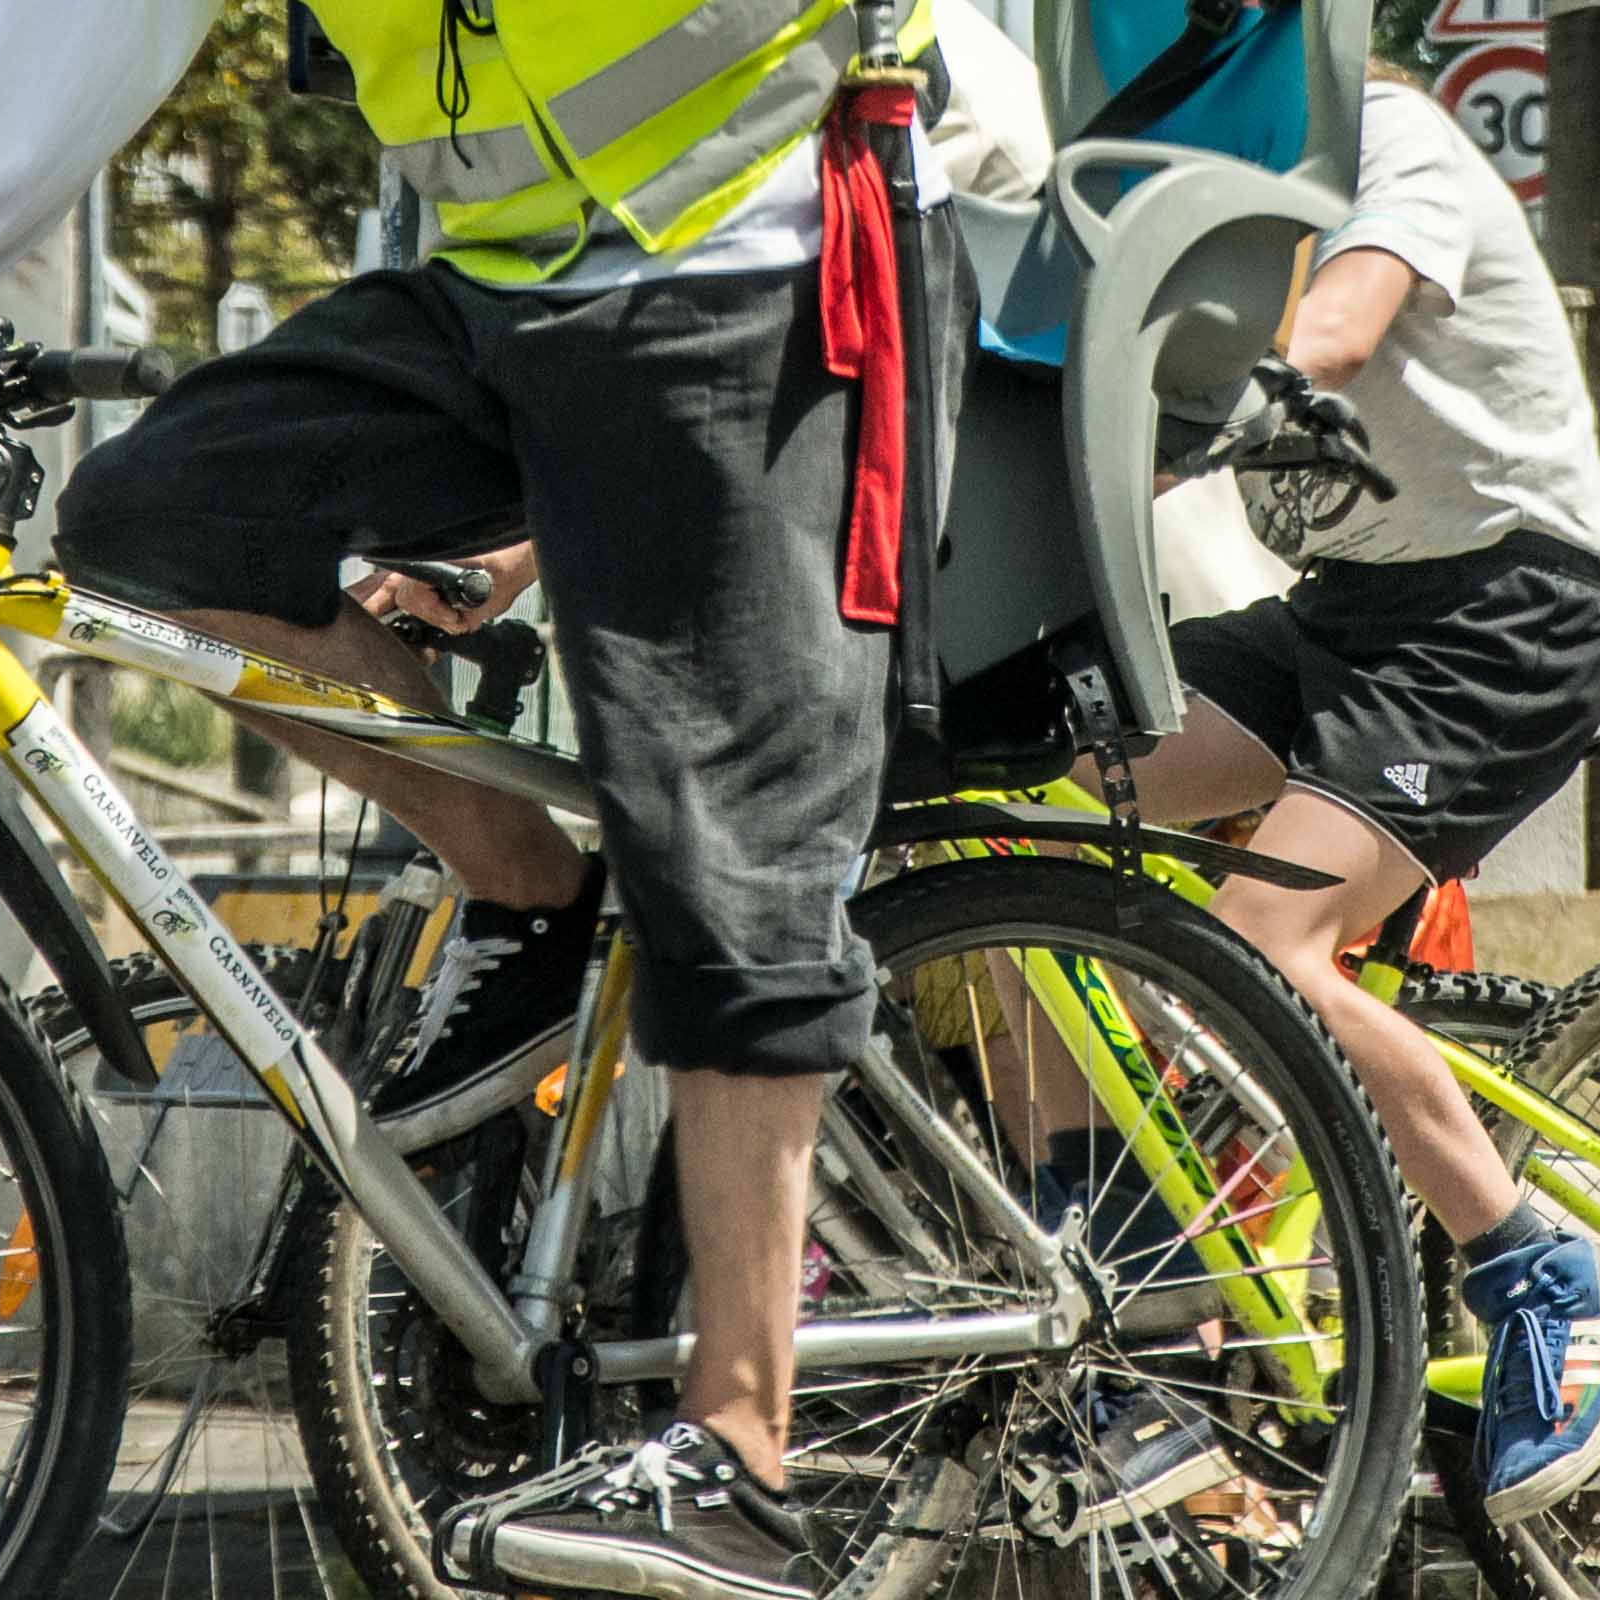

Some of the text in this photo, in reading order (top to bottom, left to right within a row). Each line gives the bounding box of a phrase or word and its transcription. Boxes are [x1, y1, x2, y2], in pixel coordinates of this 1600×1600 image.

[1468, 94, 1546, 155] 30
[82, 773, 168, 880] CARNAVELO
[1383, 767, 1428, 806] adidas
[209, 935, 294, 1041] CARNAVELO
[1375, 1255, 1394, 1345] ACROBAT
